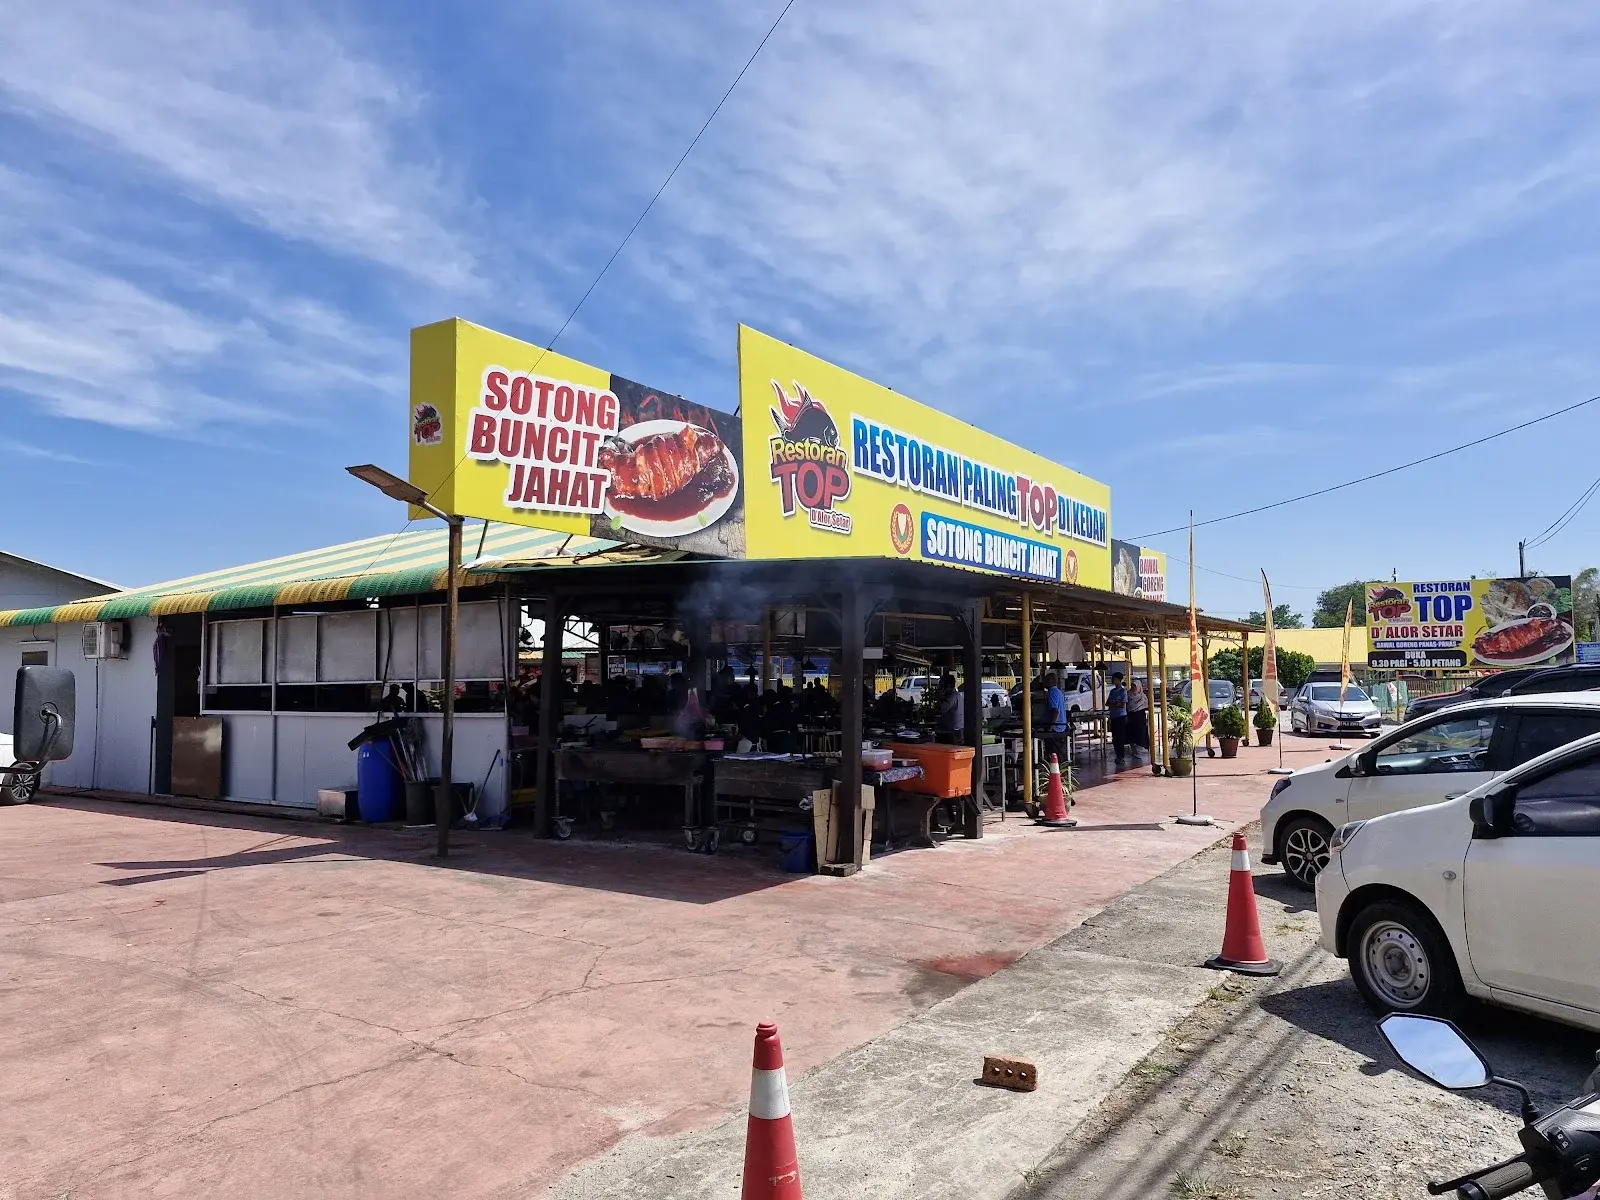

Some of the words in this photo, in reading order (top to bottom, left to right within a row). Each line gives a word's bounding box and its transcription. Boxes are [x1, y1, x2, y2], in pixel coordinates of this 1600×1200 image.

[484, 370, 617, 430] SOTONG
[414, 421, 441, 442] TOP
[470, 413, 601, 467] BUNCIT
[771, 438, 846, 468] Restoran
[508, 464, 607, 509] JAHAT
[773, 462, 849, 513] TOP
[853, 418, 959, 498] RESTORAN
[962, 459, 1017, 516] PALING
[1016, 475, 1057, 531] TOP
[1058, 495, 1071, 532] DI
[1072, 501, 1106, 543] KEDAH
[926, 517, 982, 563] SOTONG
[985, 532, 1028, 572] BUNCIT
[1029, 544, 1058, 579] JAHAT
[1140, 558, 1158, 575] BAWAL
[1143, 576, 1164, 592] GORENG
[1413, 582, 1470, 593] RESTORAN
[1368, 599, 1409, 608] Restoran
[1368, 604, 1411, 621] TOP
[1414, 595, 1472, 622] TOP
[1371, 627, 1382, 639] D'
[1385, 626, 1419, 639] ALOR
[1421, 625, 1463, 638] SETAR
[1371, 659, 1389, 668] 9.30
[1390, 659, 1407, 668] PAGI
[1413, 659, 1431, 668] 5.00
[1431, 658, 1461, 667] PETANG
[1404, 651, 1426, 659] BUKA
